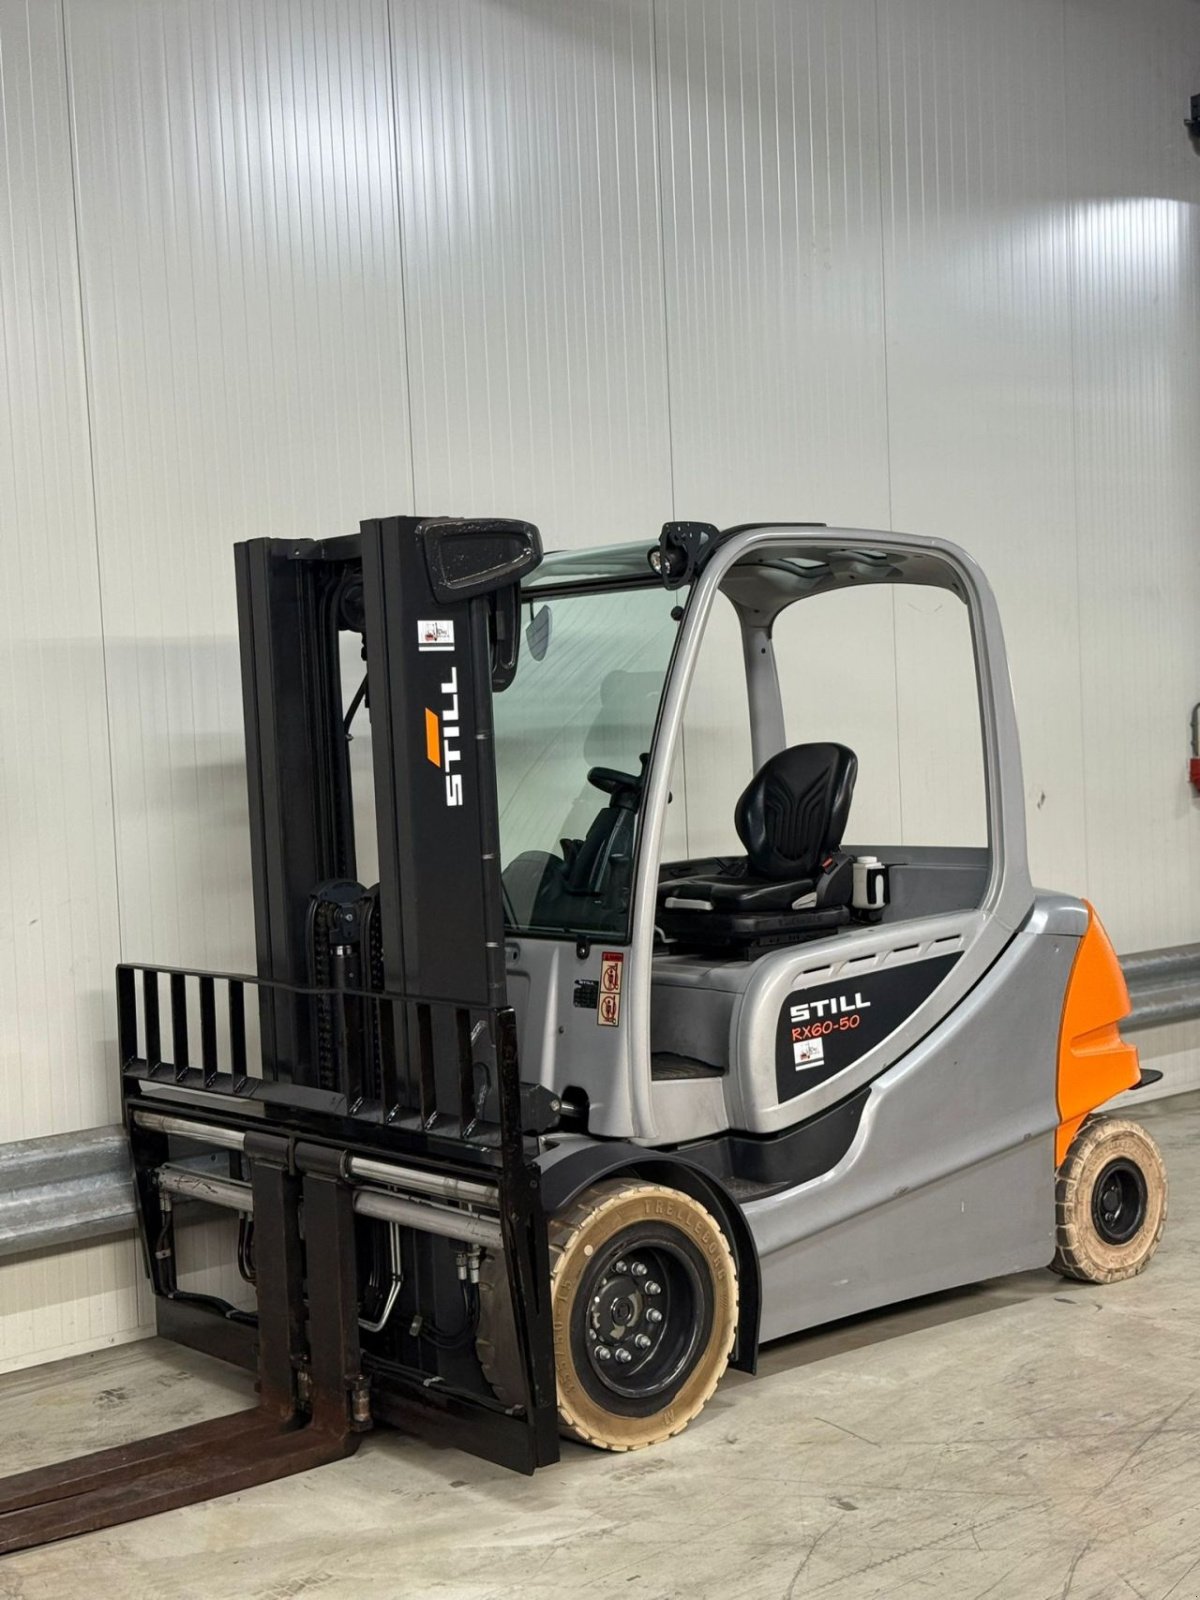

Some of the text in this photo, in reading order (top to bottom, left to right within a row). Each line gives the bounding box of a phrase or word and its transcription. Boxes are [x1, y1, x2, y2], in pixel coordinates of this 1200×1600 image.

[441, 666, 463, 806] STILL
[790, 992, 871, 1023] STILL
[791, 1014, 861, 1042] RX60-50
[644, 1199, 728, 1281] TRELLEBORG
